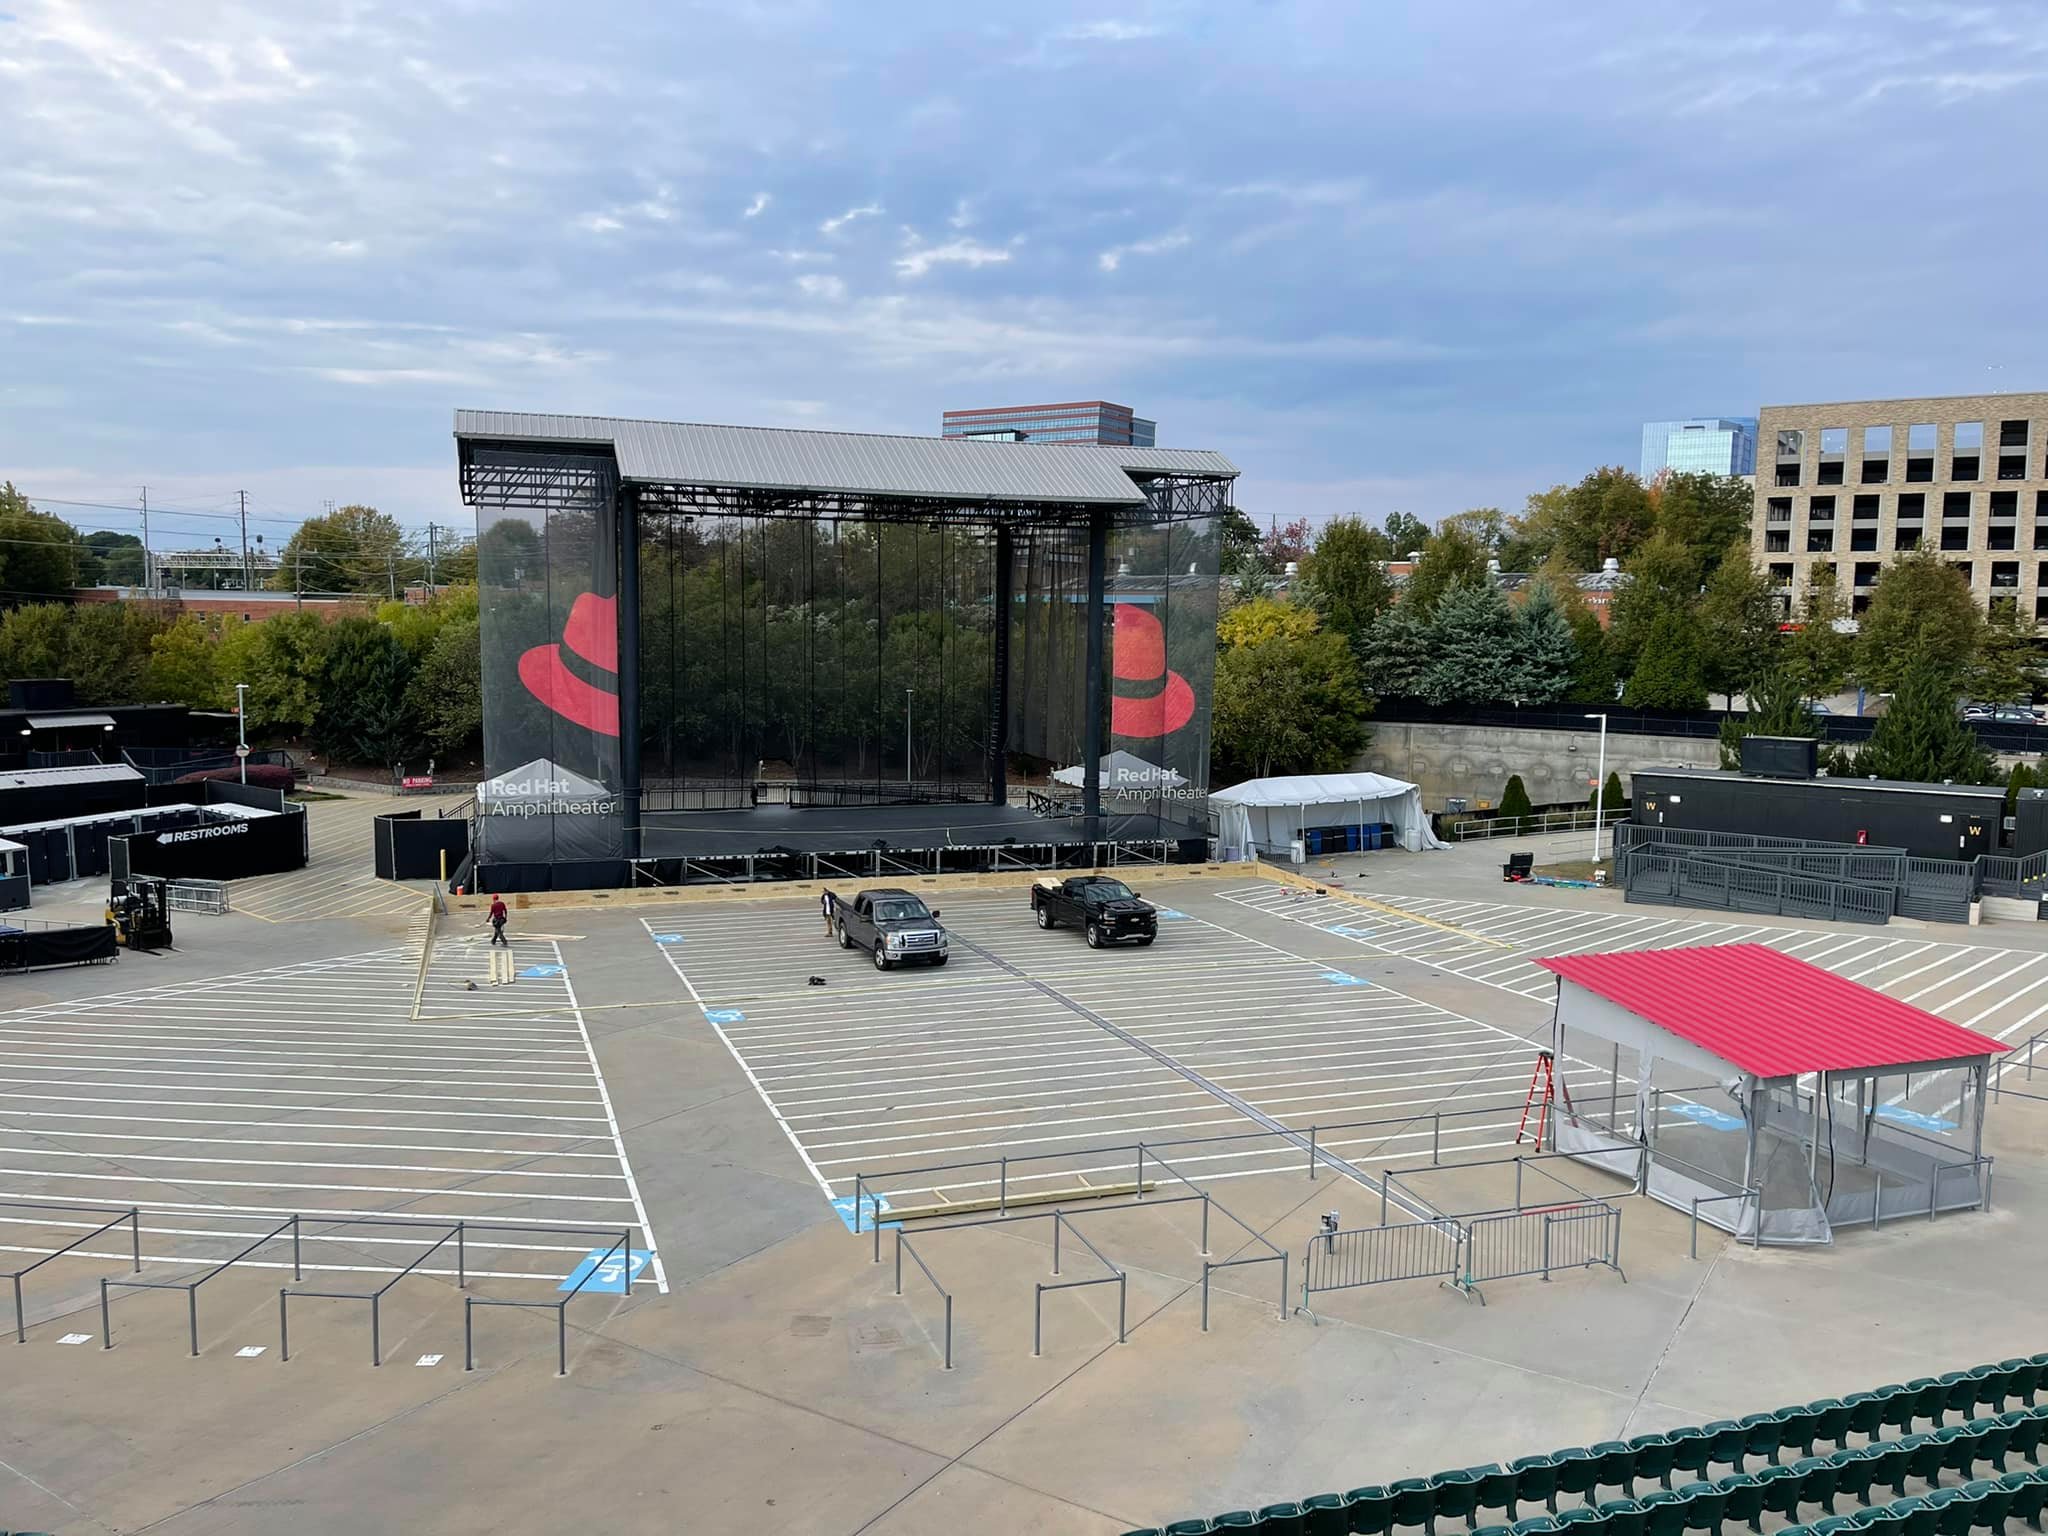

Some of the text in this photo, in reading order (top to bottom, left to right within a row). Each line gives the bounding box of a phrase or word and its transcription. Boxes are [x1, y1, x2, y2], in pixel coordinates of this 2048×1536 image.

[1118, 768, 1178, 782] Red Hat
[492, 778, 570, 795] Red Hat
[492, 800, 617, 820] Amphitheater
[1646, 802, 1656, 810] W
[174, 823, 249, 842] RESTROOMS
[1969, 826, 1982, 836] W
